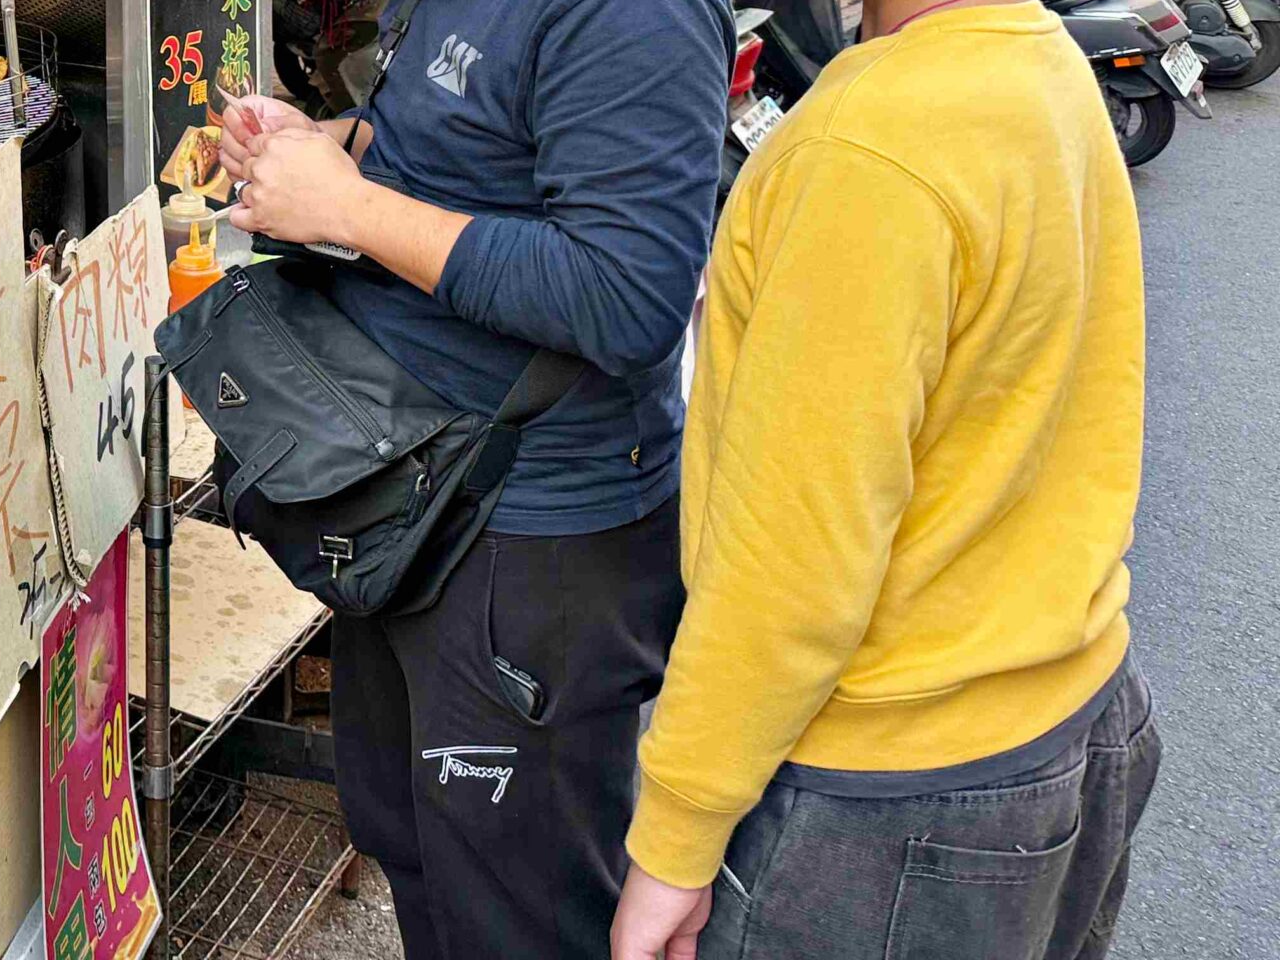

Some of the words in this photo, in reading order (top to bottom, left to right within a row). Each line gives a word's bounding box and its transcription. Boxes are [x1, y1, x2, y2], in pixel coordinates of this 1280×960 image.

[159, 30, 204, 91] 35
[96, 351, 136, 463] 45
[101, 702, 123, 798] 60
[422, 745, 518, 803] Tommy
[101, 796, 137, 914] 100
